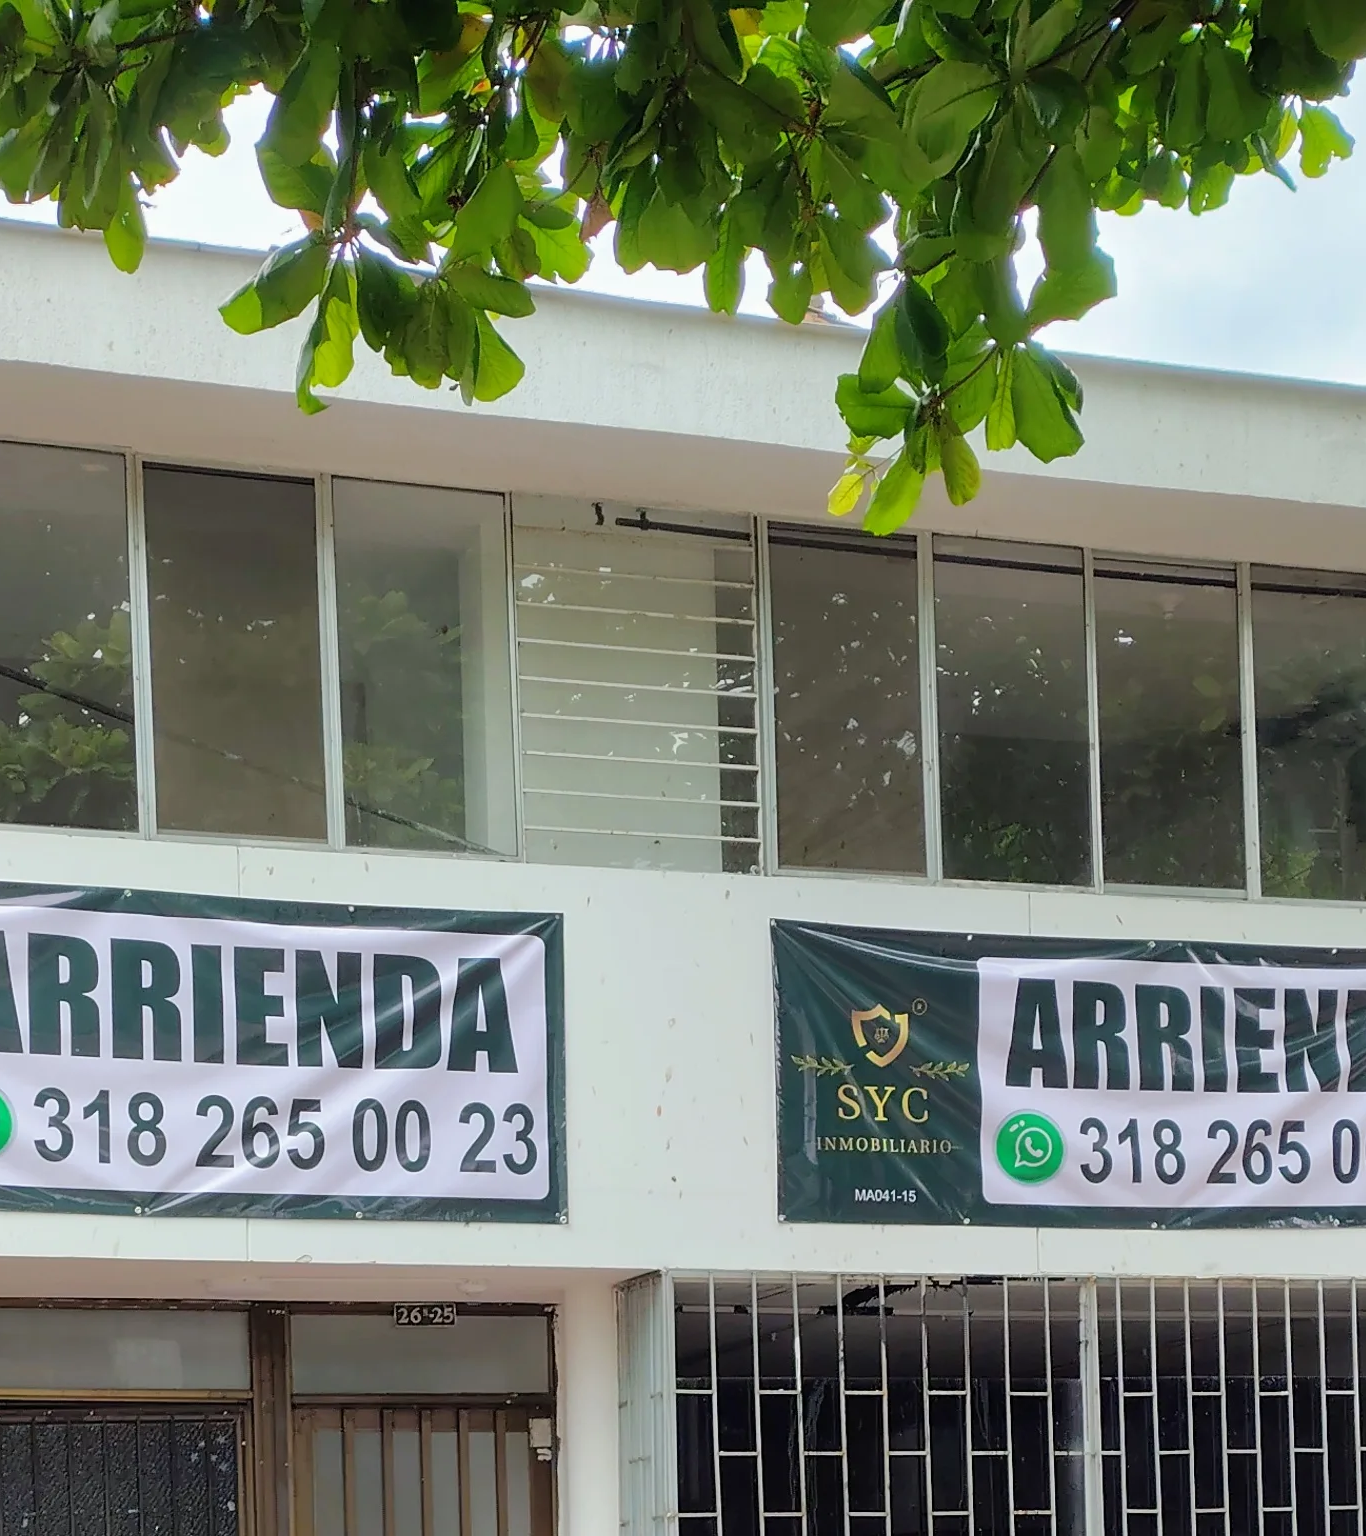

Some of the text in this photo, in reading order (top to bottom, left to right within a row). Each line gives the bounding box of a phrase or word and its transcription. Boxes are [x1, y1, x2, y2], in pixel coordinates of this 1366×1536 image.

[837, 1083, 929, 1123] SYC
[33, 1087, 538, 1176] 318 265 00 23
[816, 1136, 953, 1155] INMOBILIARIO
[1079, 1117, 1187, 1186] 318
[1206, 1119, 1311, 1184] 265
[854, 1188, 918, 1204] MA041-15
